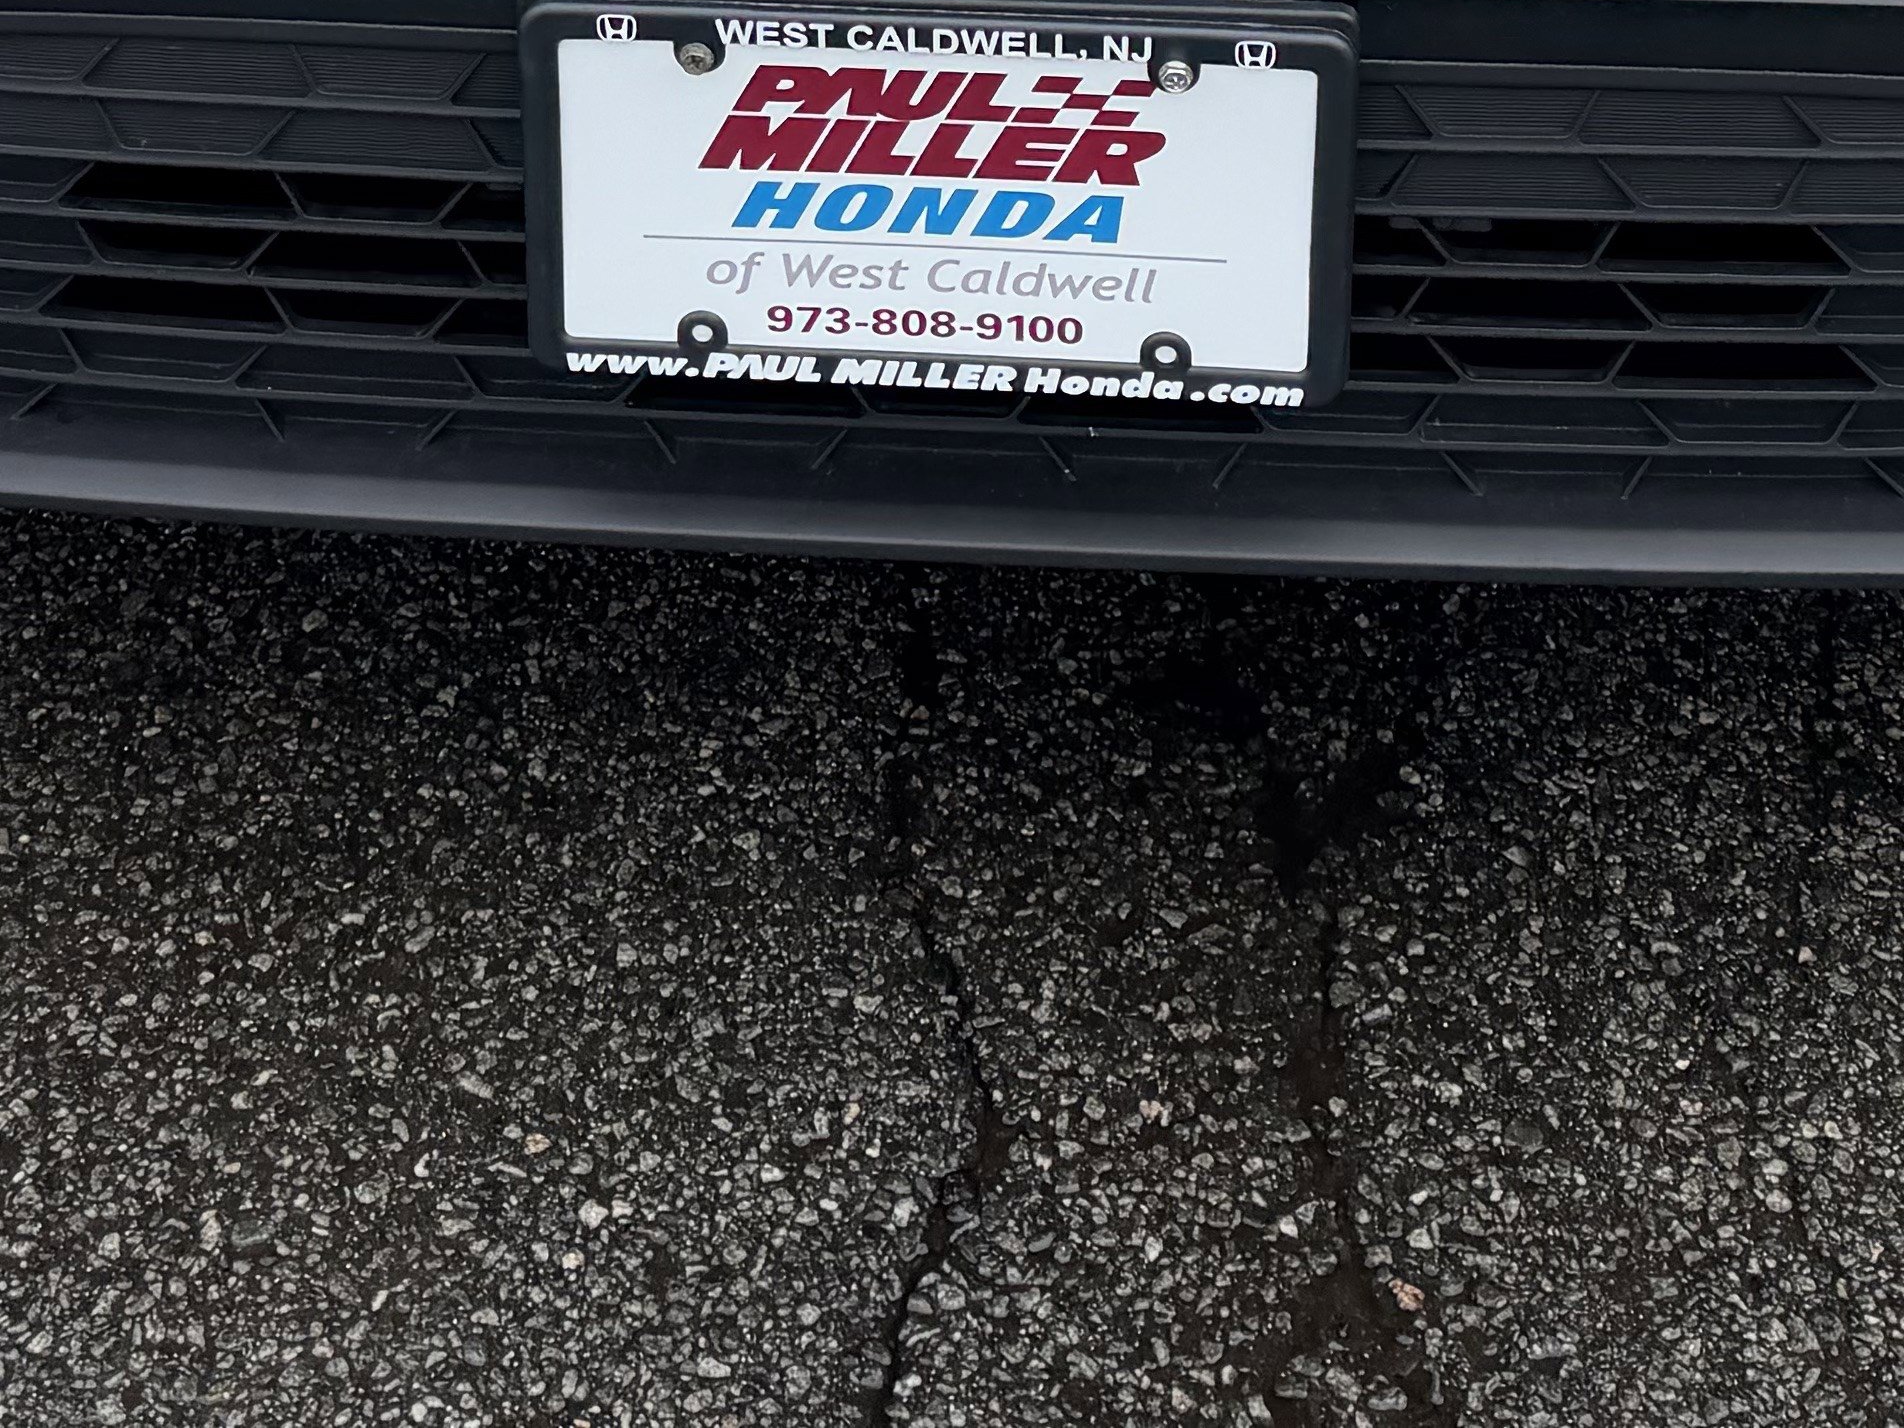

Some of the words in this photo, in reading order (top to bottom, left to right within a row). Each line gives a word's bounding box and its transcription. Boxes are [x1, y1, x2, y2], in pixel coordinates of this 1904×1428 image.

[714, 18, 835, 49] WEST
[846, 25, 1088, 61] CALDWELL,
[1102, 35, 1153, 63] NJ
[731, 64, 1016, 123] PAUL
[697, 114, 1167, 186] MILLER
[731, 181, 1125, 244] HONDA
[706, 252, 767, 294] of
[781, 252, 910, 291] West
[926, 259, 1157, 304] Caldwell
[766, 305, 1084, 344] 973-808-9100
